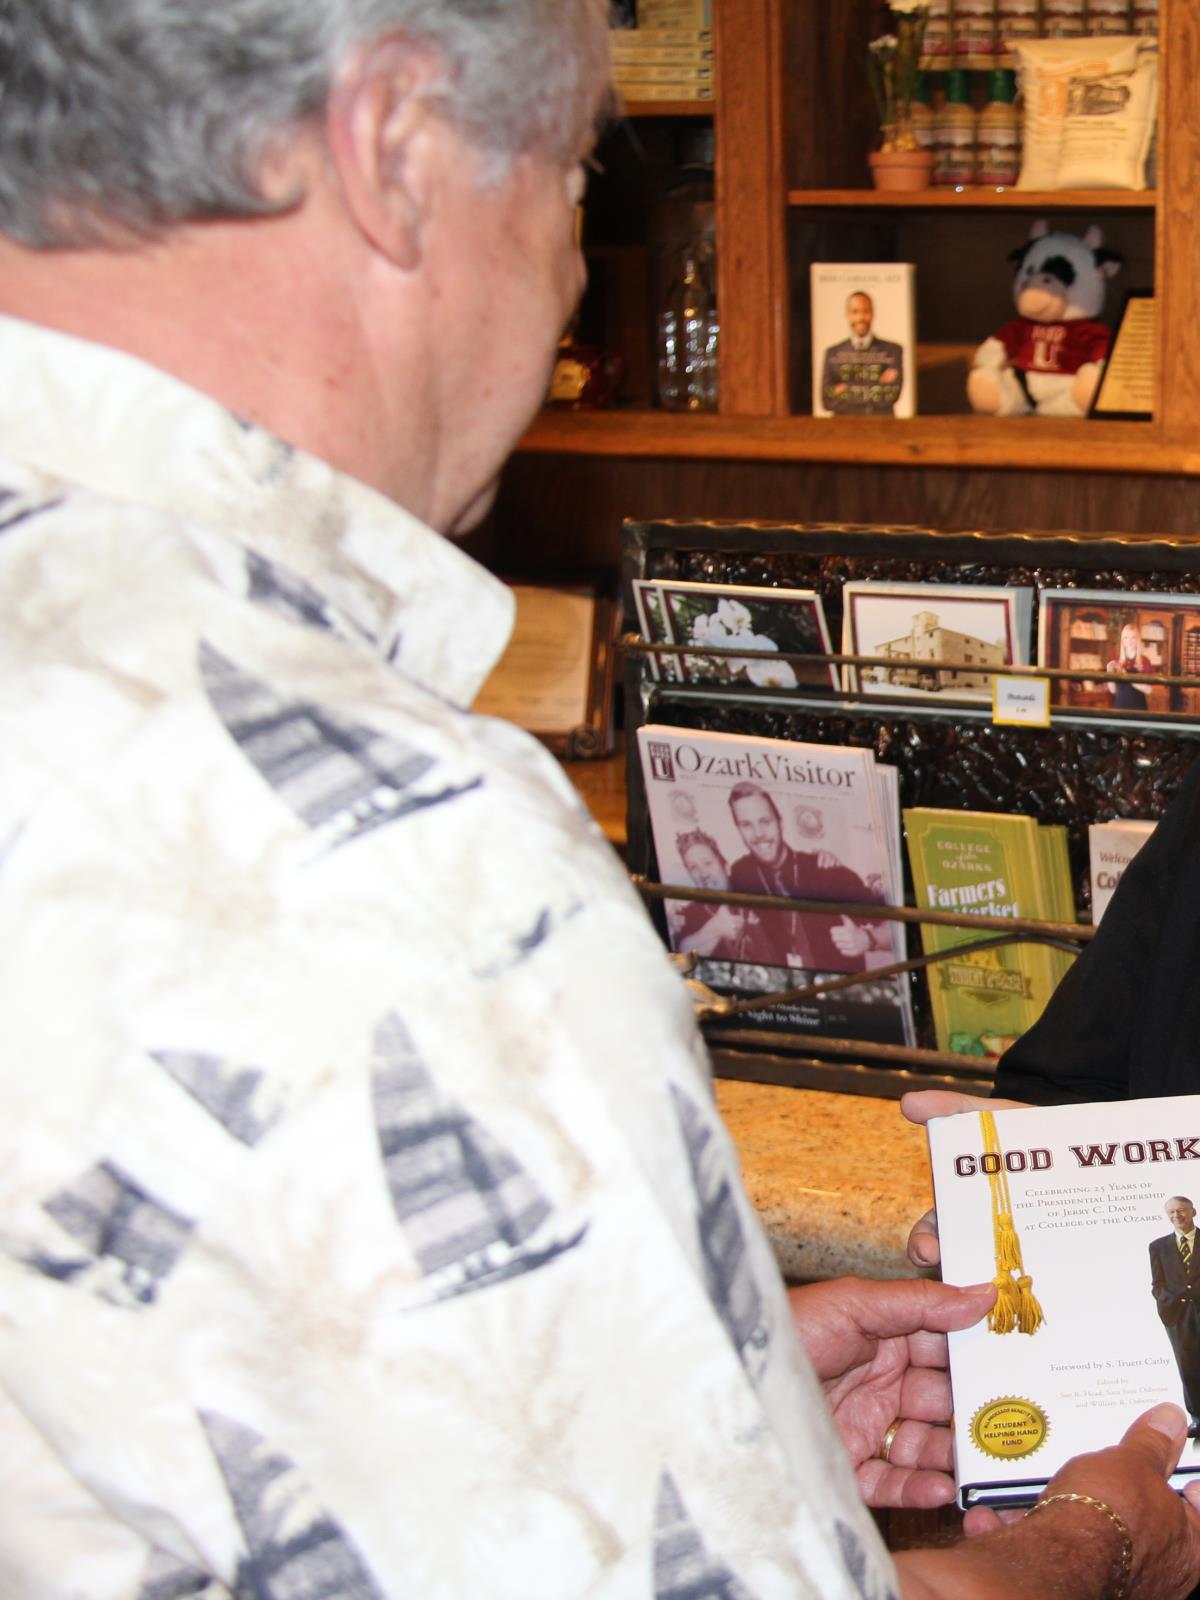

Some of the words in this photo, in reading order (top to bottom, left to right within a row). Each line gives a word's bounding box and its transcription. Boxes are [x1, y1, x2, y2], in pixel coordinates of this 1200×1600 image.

[937, 840, 991, 853] COLLEGE
[942, 861, 992, 873] OZARKS
[927, 878, 1007, 907] Farmers
[790, 1014, 821, 1026] Shine
[954, 1148, 1053, 1178] GOOD
[1025, 1186, 1090, 1198] CELEBRATING
[1108, 1183, 1137, 1191] YEARS
[1037, 1197, 1105, 1207] PRESIDENTIAL
[1107, 1192, 1166, 1202] LEADERSHIP
[1063, 1208, 1090, 1218] JERRY
[1108, 1205, 1137, 1213] DAVIS
[1038, 1221, 1083, 1229] COLLEGE
[1050, 1362, 1091, 1371] Foreword
[1093, 1362, 1103, 1370] by
[1144, 1357, 1170, 1366] Cathy
[994, 1421, 1027, 1429] STUDENT
[984, 1430, 1015, 1438] HELPING
